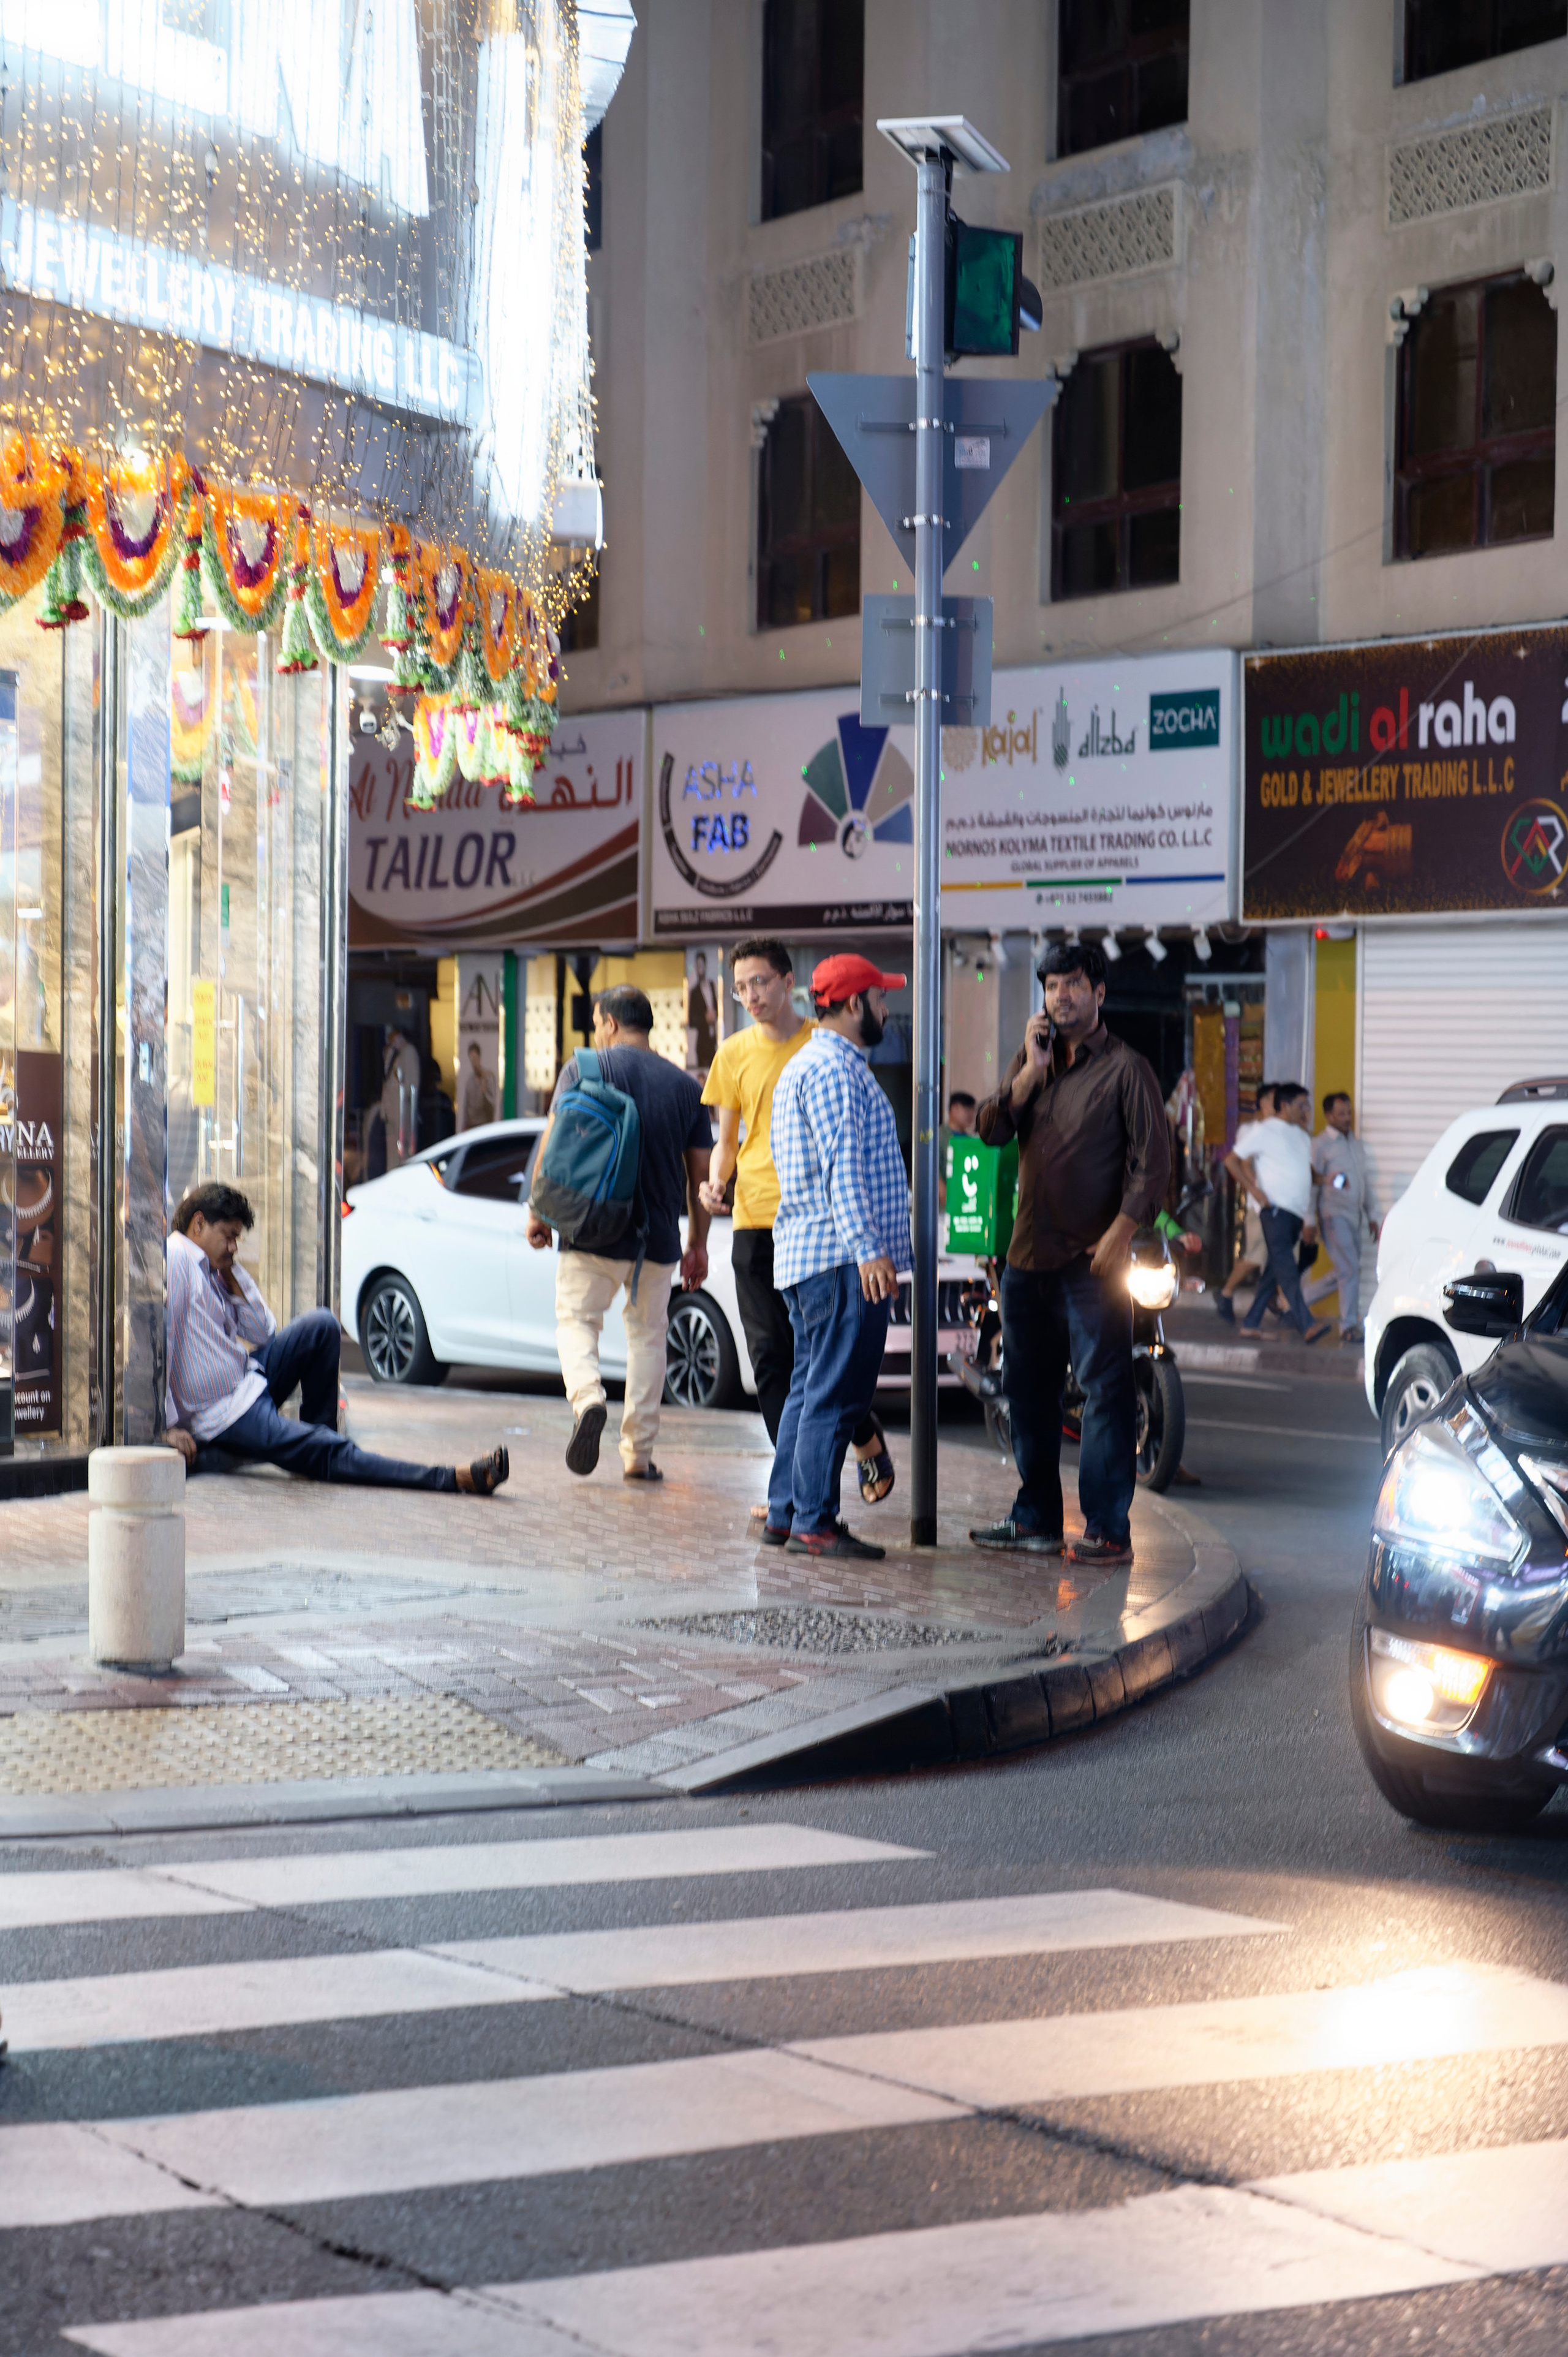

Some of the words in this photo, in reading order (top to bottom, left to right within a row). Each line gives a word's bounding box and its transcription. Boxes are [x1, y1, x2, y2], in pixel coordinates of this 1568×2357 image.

[8, 214, 235, 338] JEWELLERY
[249, 287, 394, 390] TRADING
[405, 337, 459, 410] LLC
[1153, 705, 1216, 735] ZOCHA
[1261, 690, 1359, 759] wadi
[1369, 686, 1408, 752] al
[1418, 680, 1516, 749] raha
[682, 760, 757, 801] ASHA
[1261, 771, 1298, 807] GOLD
[1302, 770, 1313, 806] &
[1316, 763, 1400, 804] JEWELLERY
[1402, 758, 1468, 799] TRADING
[691, 812, 750, 853] FAB
[946, 838, 997, 857] MORNOS
[999, 836, 1047, 855] KOLYMA
[1050, 833, 1096, 853] TEXTILE
[1100, 830, 1155, 850] TRADING
[1159, 829, 1179, 847] CO.
[366, 831, 516, 891] TAILOR
[40, 1390, 51, 1403] on
